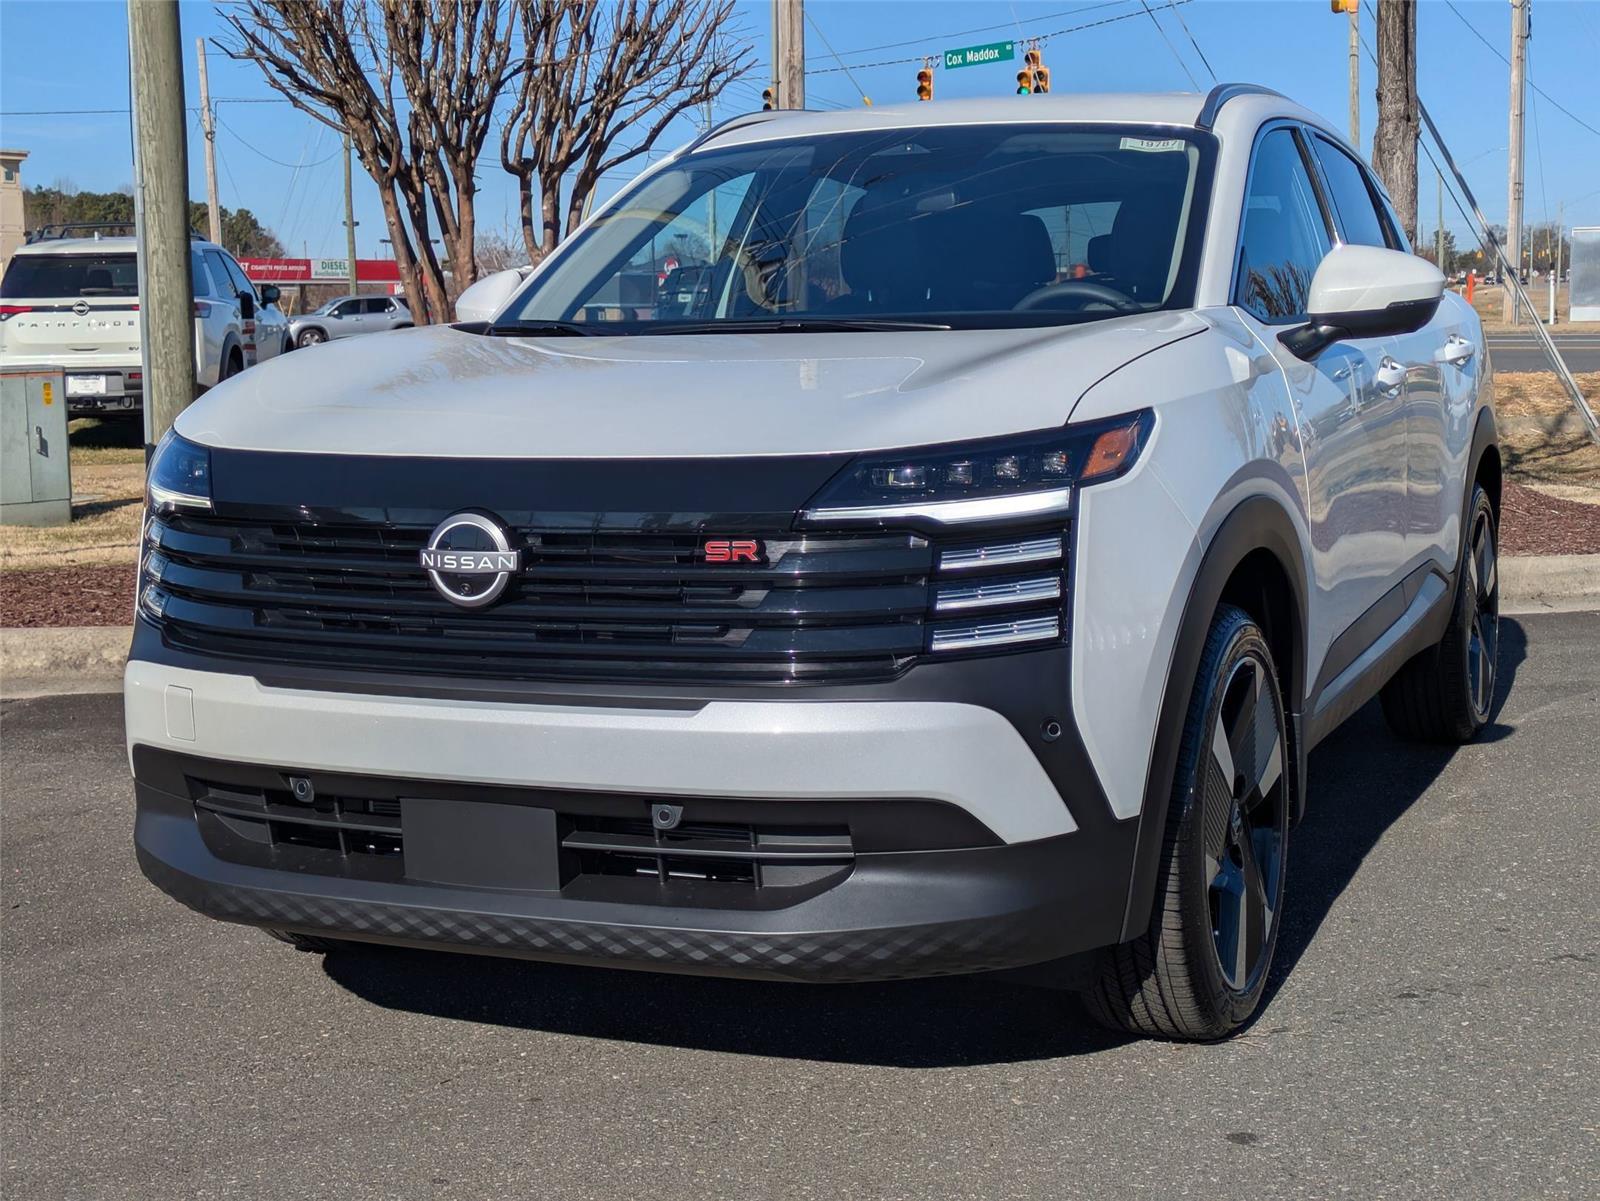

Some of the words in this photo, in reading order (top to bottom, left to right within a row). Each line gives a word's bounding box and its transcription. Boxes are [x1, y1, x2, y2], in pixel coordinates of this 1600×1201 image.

[946, 53, 963, 66] Cox
[966, 48, 1000, 63] Maddox
[321, 261, 348, 270] DIESEL
[18, 320, 135, 328] PATHFINDE
[705, 541, 759, 561] SR
[422, 552, 514, 569] NISSAN
